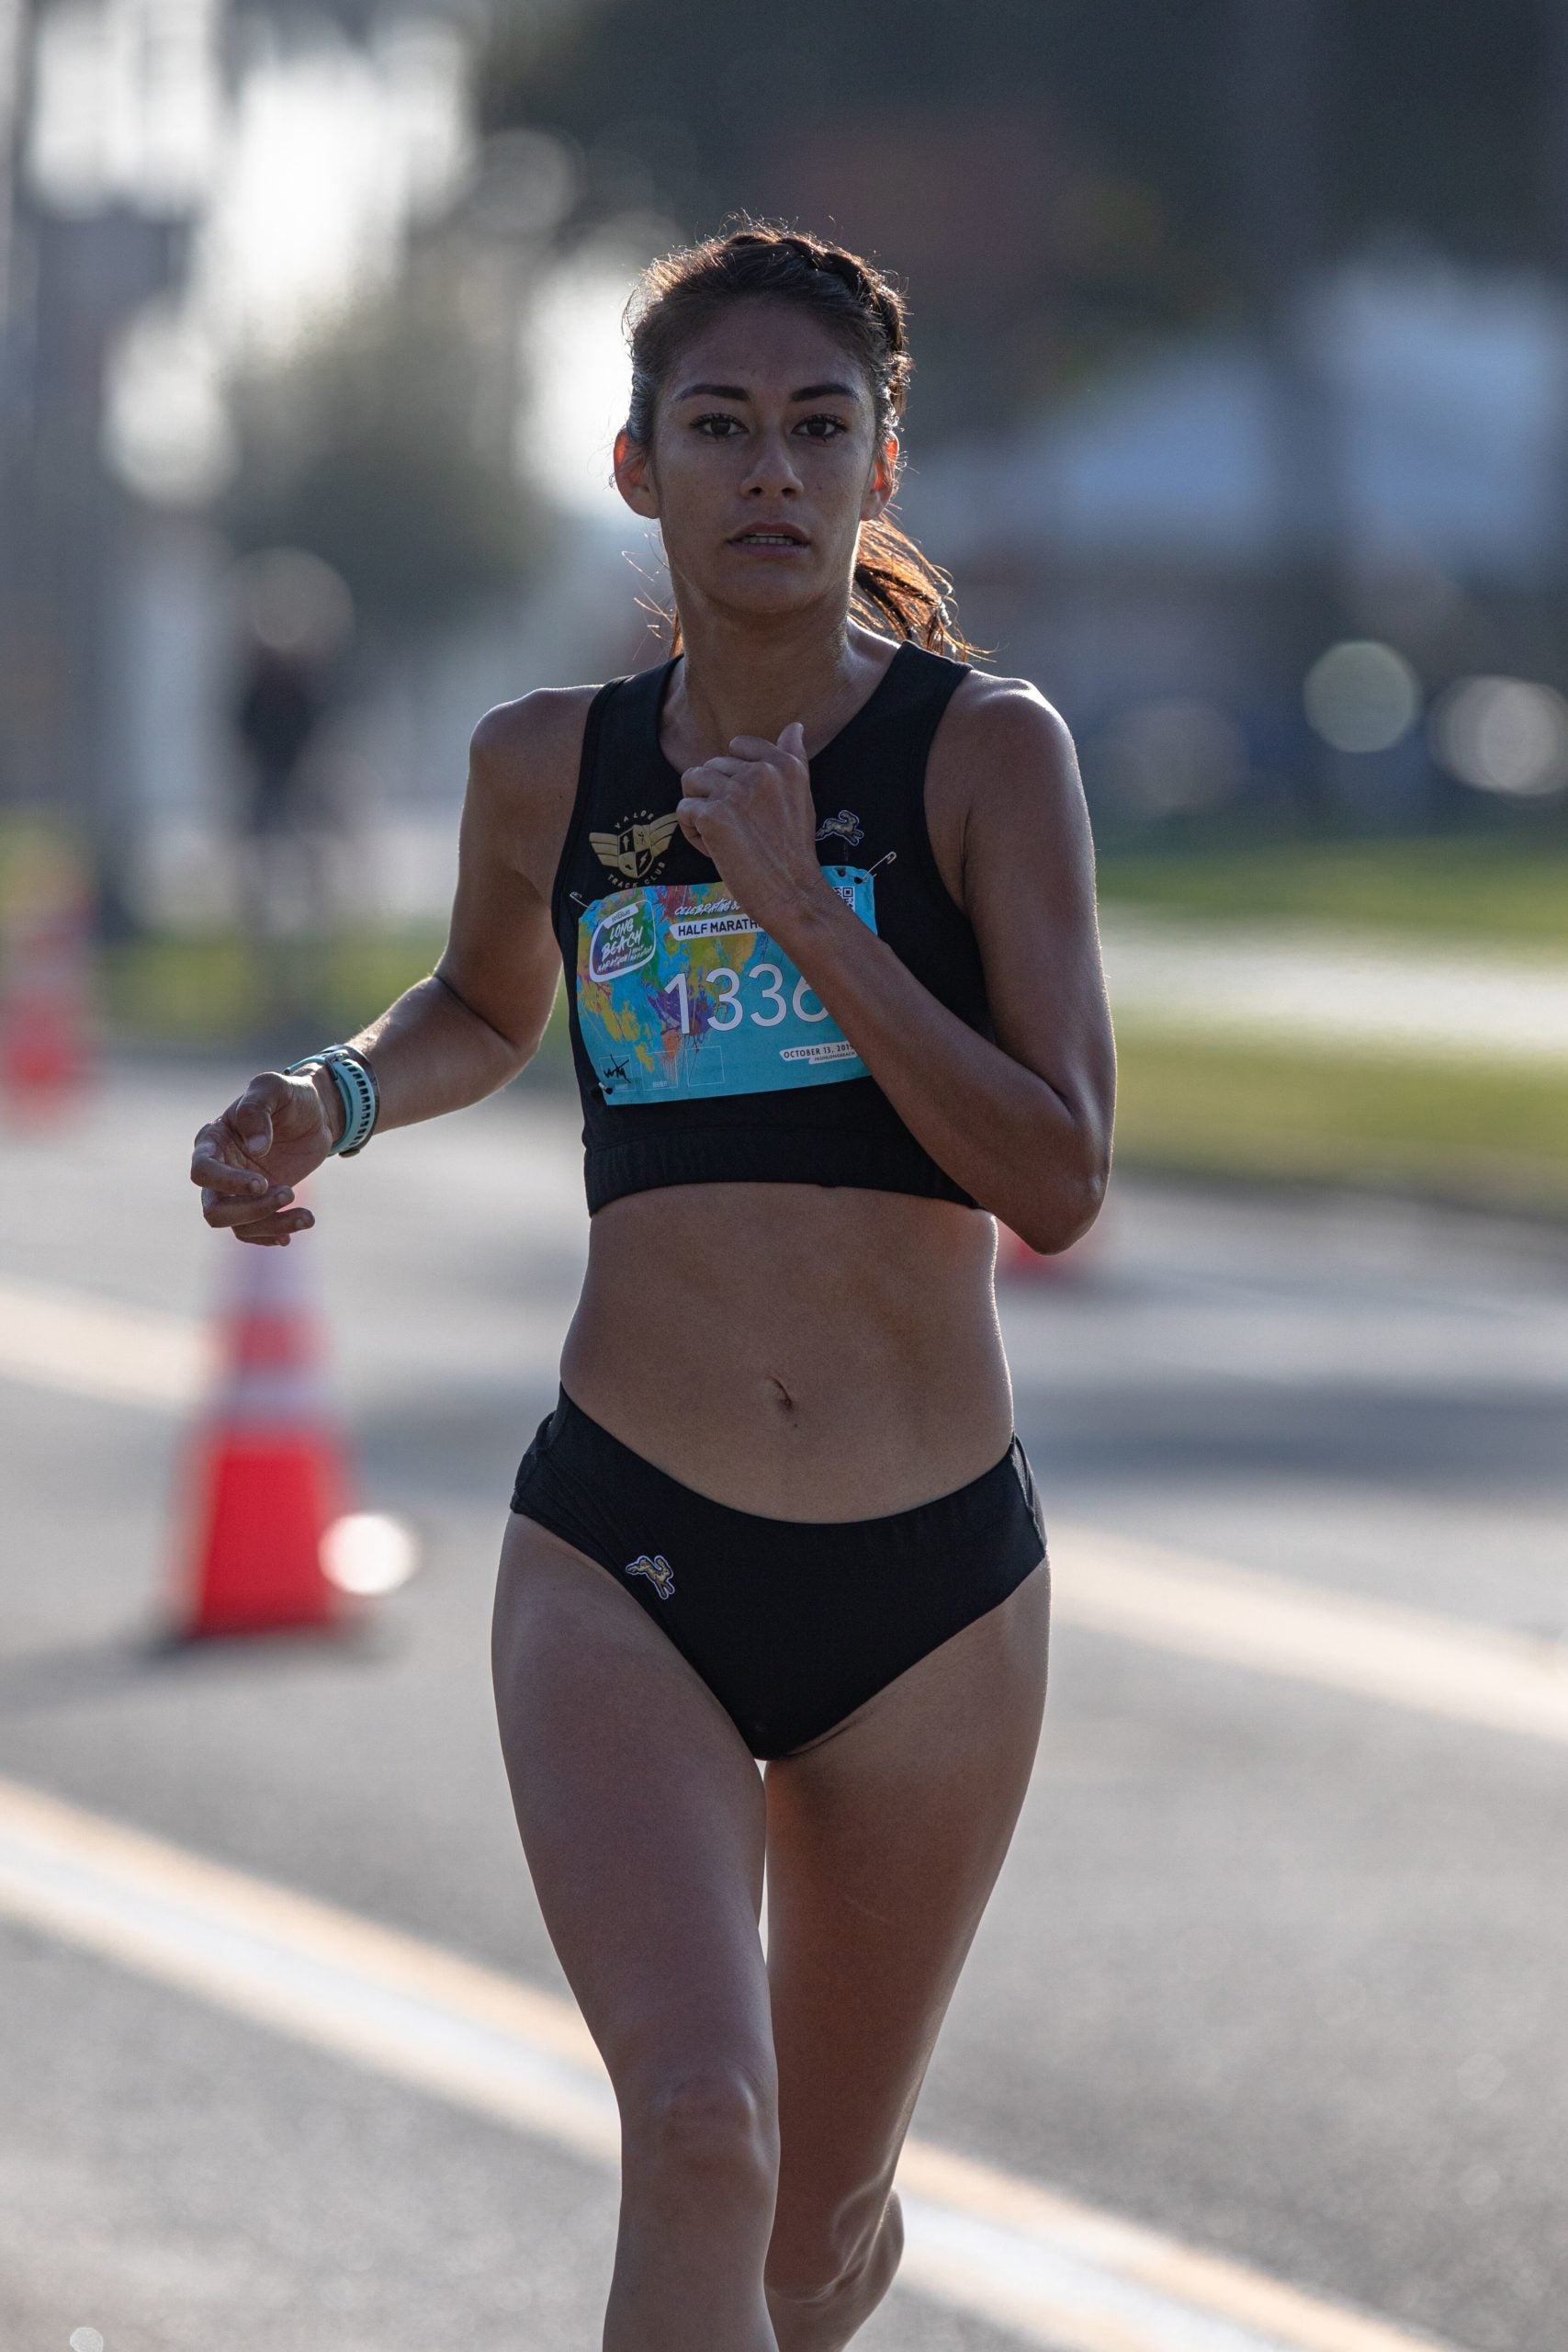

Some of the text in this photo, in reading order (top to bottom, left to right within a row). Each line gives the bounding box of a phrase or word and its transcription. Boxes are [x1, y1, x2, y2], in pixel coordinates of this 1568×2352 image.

[615, 810, 654, 829] VALOR
[608, 862, 665, 888] TRACK CLUB
[609, 918, 634, 941] LONG
[678, 919, 760, 936] HALF MARATH
[601, 926, 644, 962] BEACH
[664, 963, 829, 1034] 1336
[784, 1047, 820, 1058] OCTOBER
